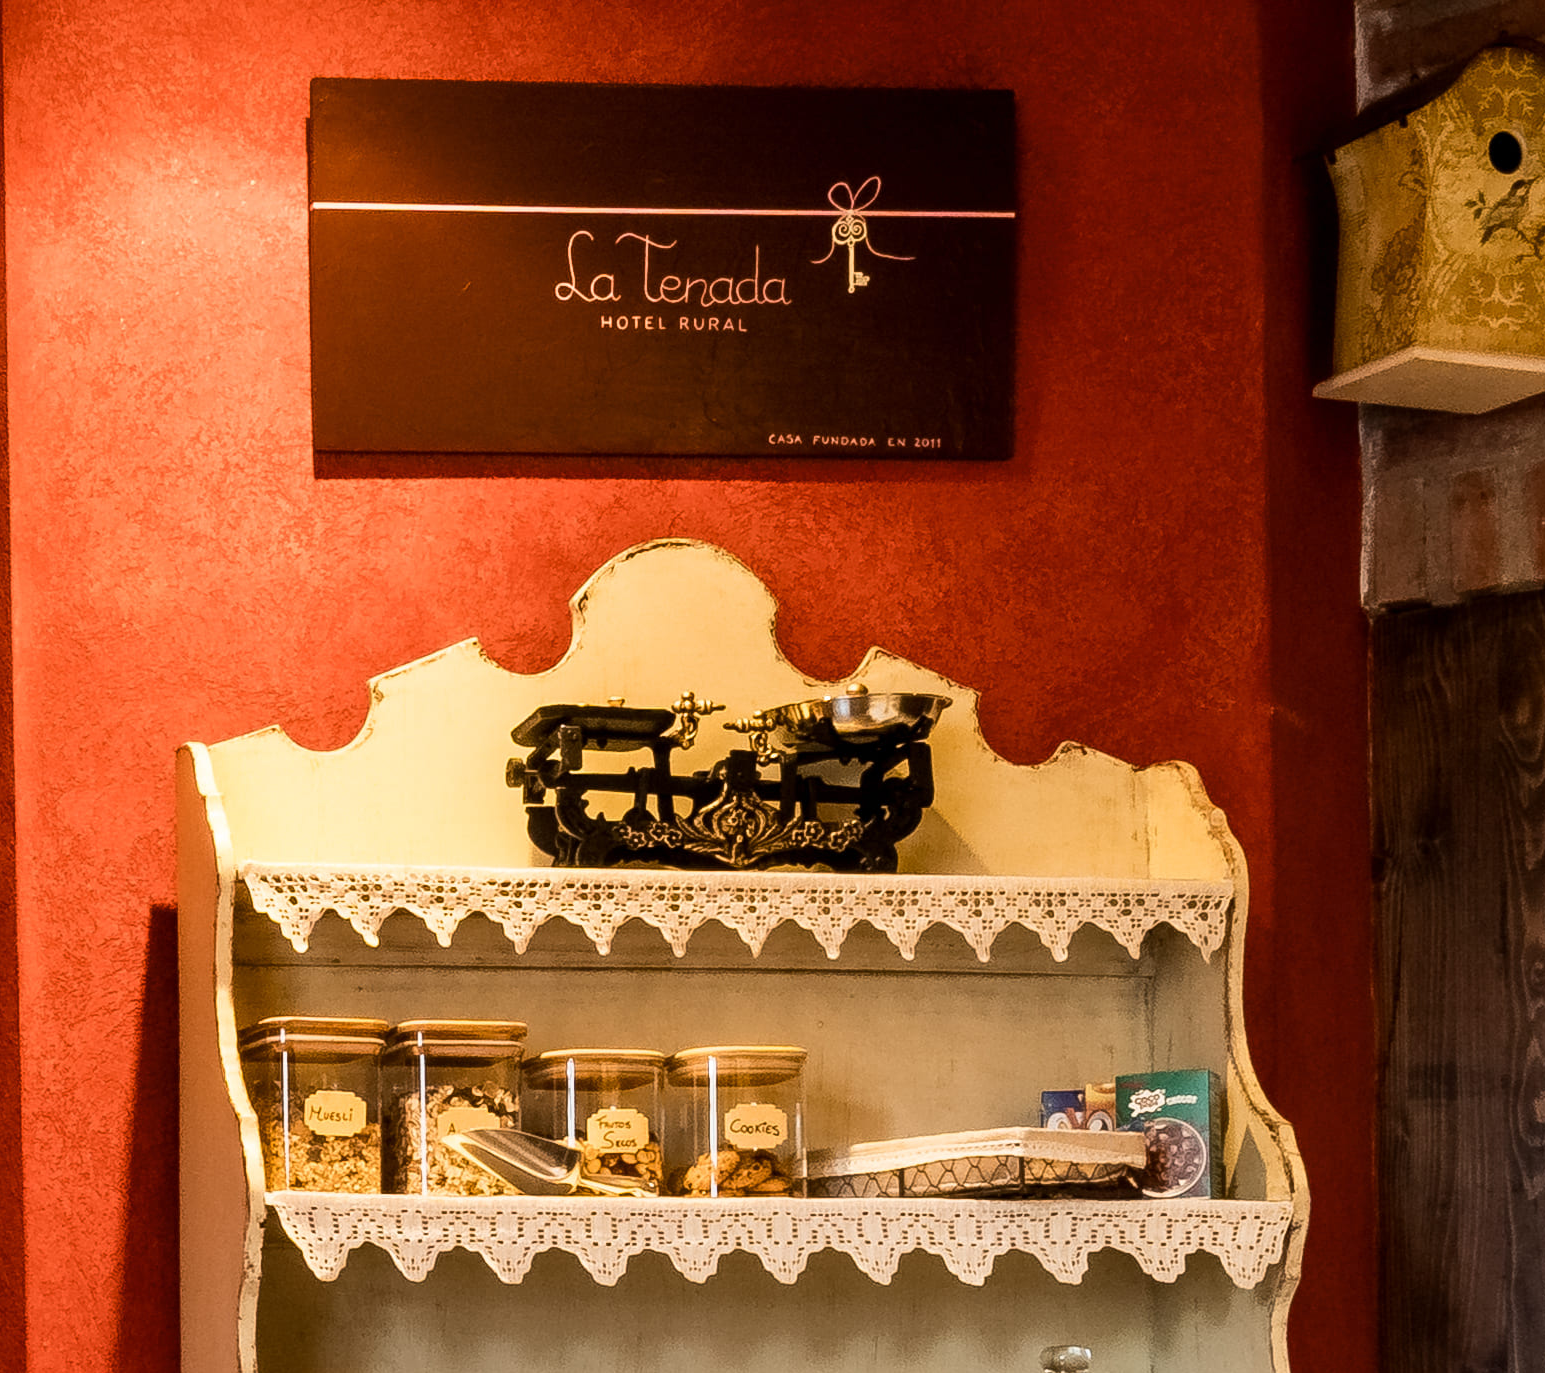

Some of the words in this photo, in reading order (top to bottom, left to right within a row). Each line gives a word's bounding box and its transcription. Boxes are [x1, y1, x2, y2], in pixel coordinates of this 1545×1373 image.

[555, 230, 621, 302] La
[615, 232, 792, 307] Tenada
[601, 315, 667, 330] HOTEL
[679, 316, 748, 332] RURAL
[768, 433, 803, 445] CASA
[812, 435, 877, 447] FUNDADA
[887, 437, 906, 447] EN
[914, 437, 942, 448] 2011
